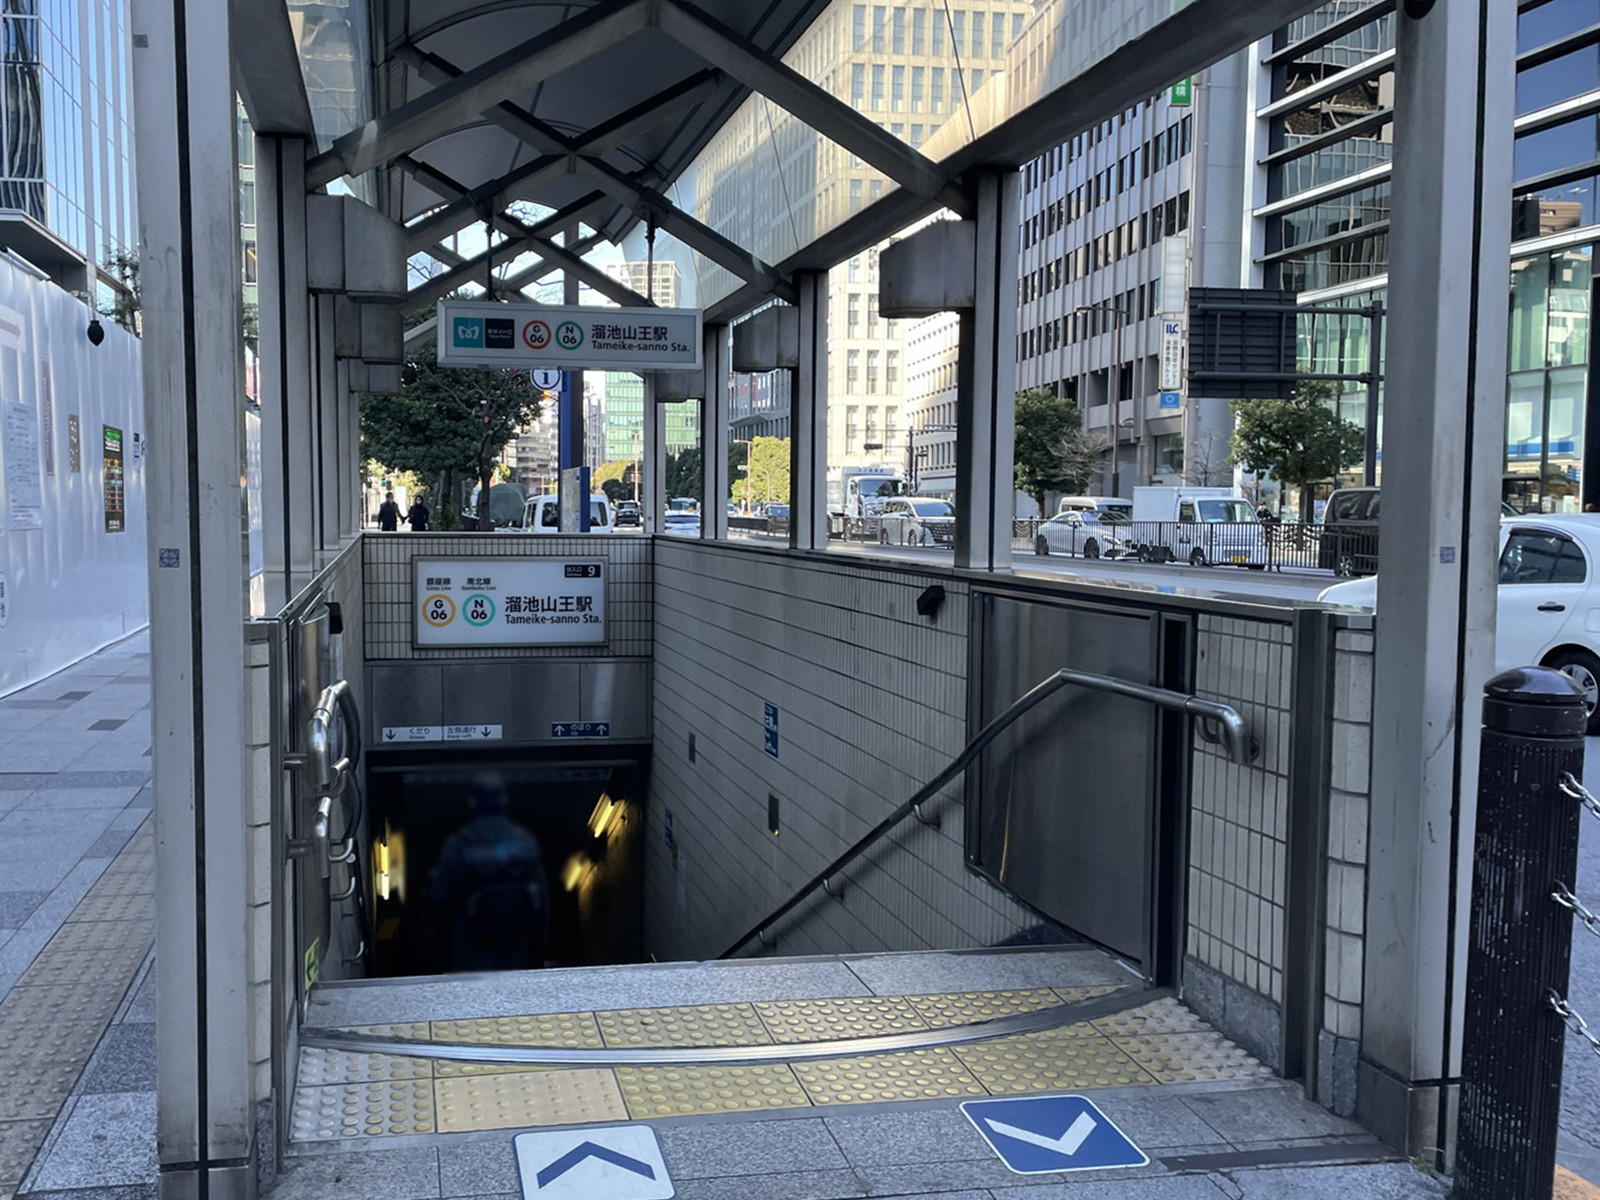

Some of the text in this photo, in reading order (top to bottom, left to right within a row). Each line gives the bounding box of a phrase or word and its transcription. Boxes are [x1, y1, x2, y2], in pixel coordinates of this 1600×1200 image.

[533, 325, 541, 333] G
[565, 326, 574, 334] N
[591, 324, 668, 341] 溜池山王駅
[1166, 324, 1179, 334] ILC
[530, 334, 544, 344] 06
[562, 335, 577, 344] 06
[591, 341, 690, 352] Tameike-sanno Sta.
[587, 566, 596, 577] 9
[466, 577, 491, 586] 南北線
[434, 599, 443, 608] G
[474, 599, 484, 608] N
[505, 596, 592, 613] 溜池山王駅
[430, 609, 447, 620] 06
[470, 609, 487, 620] 06
[505, 614, 602, 625] Tameike-sanno Sta.
[409, 727, 430, 735] くだり
